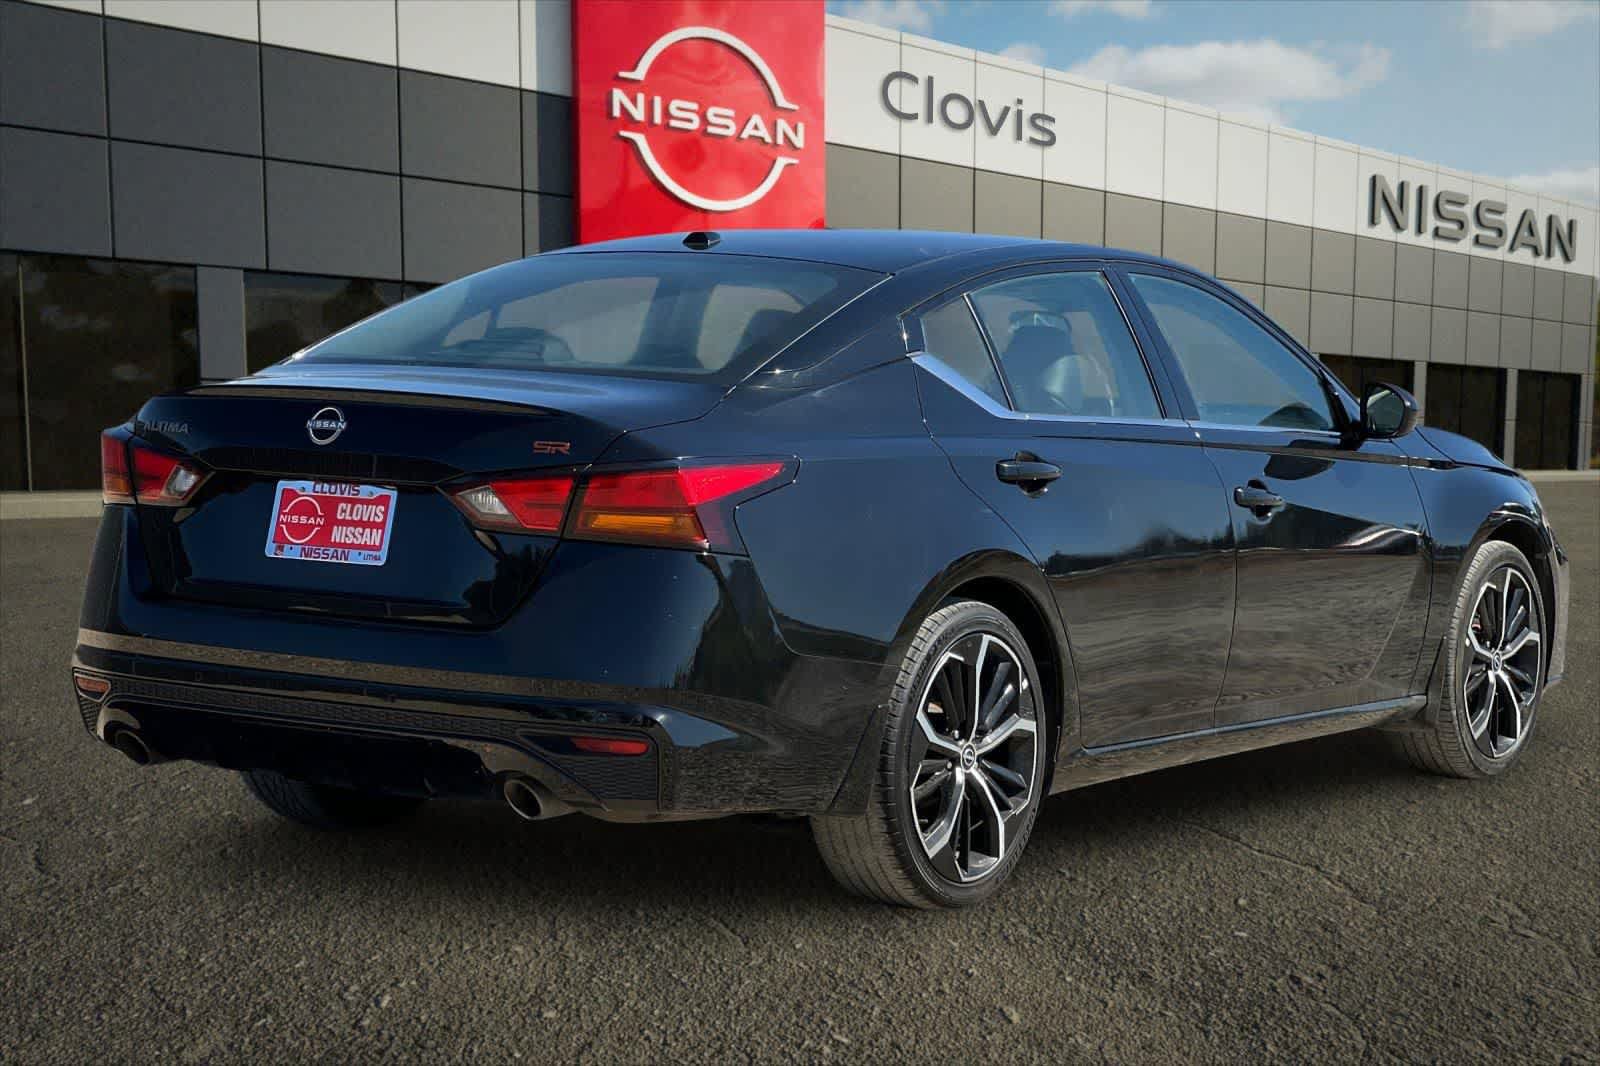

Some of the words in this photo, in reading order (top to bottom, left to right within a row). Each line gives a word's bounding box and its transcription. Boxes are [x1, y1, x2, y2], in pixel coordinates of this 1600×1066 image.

[882, 70, 1057, 147] Clovis
[611, 87, 805, 149] NISSAN
[1369, 173, 1578, 263] NISSAN
[306, 419, 347, 430] NISSAN
[533, 440, 571, 456] SR
[312, 480, 361, 496] CLOVIS
[279, 514, 325, 526] NISSAN
[336, 502, 385, 523] CLOVIS
[331, 525, 382, 545] NISSAN
[299, 546, 351, 561] NISSAN
